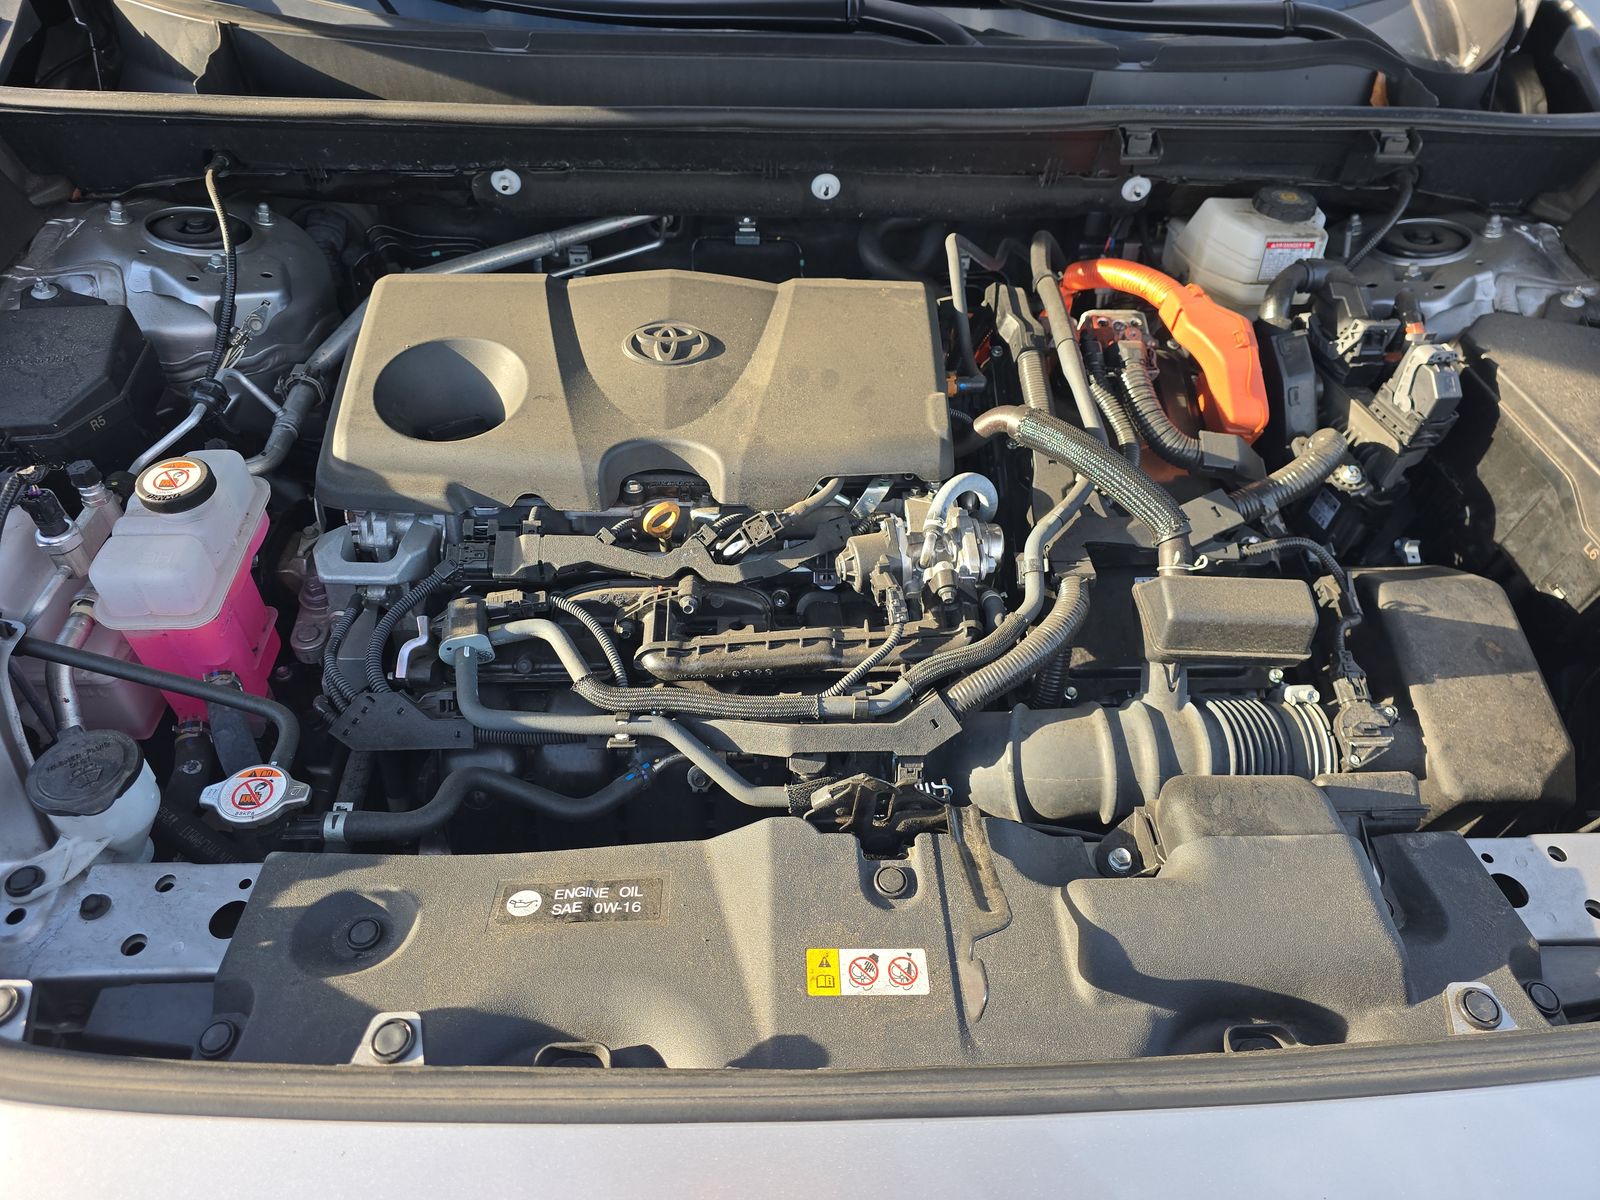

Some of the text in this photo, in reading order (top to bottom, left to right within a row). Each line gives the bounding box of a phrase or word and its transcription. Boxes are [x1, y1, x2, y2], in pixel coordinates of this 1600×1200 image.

[90, 416, 106, 431] R5
[1583, 541, 1599, 560] L6
[554, 886, 643, 900] ENGINE OIL
[551, 901, 641, 915] SAE 0W-16
